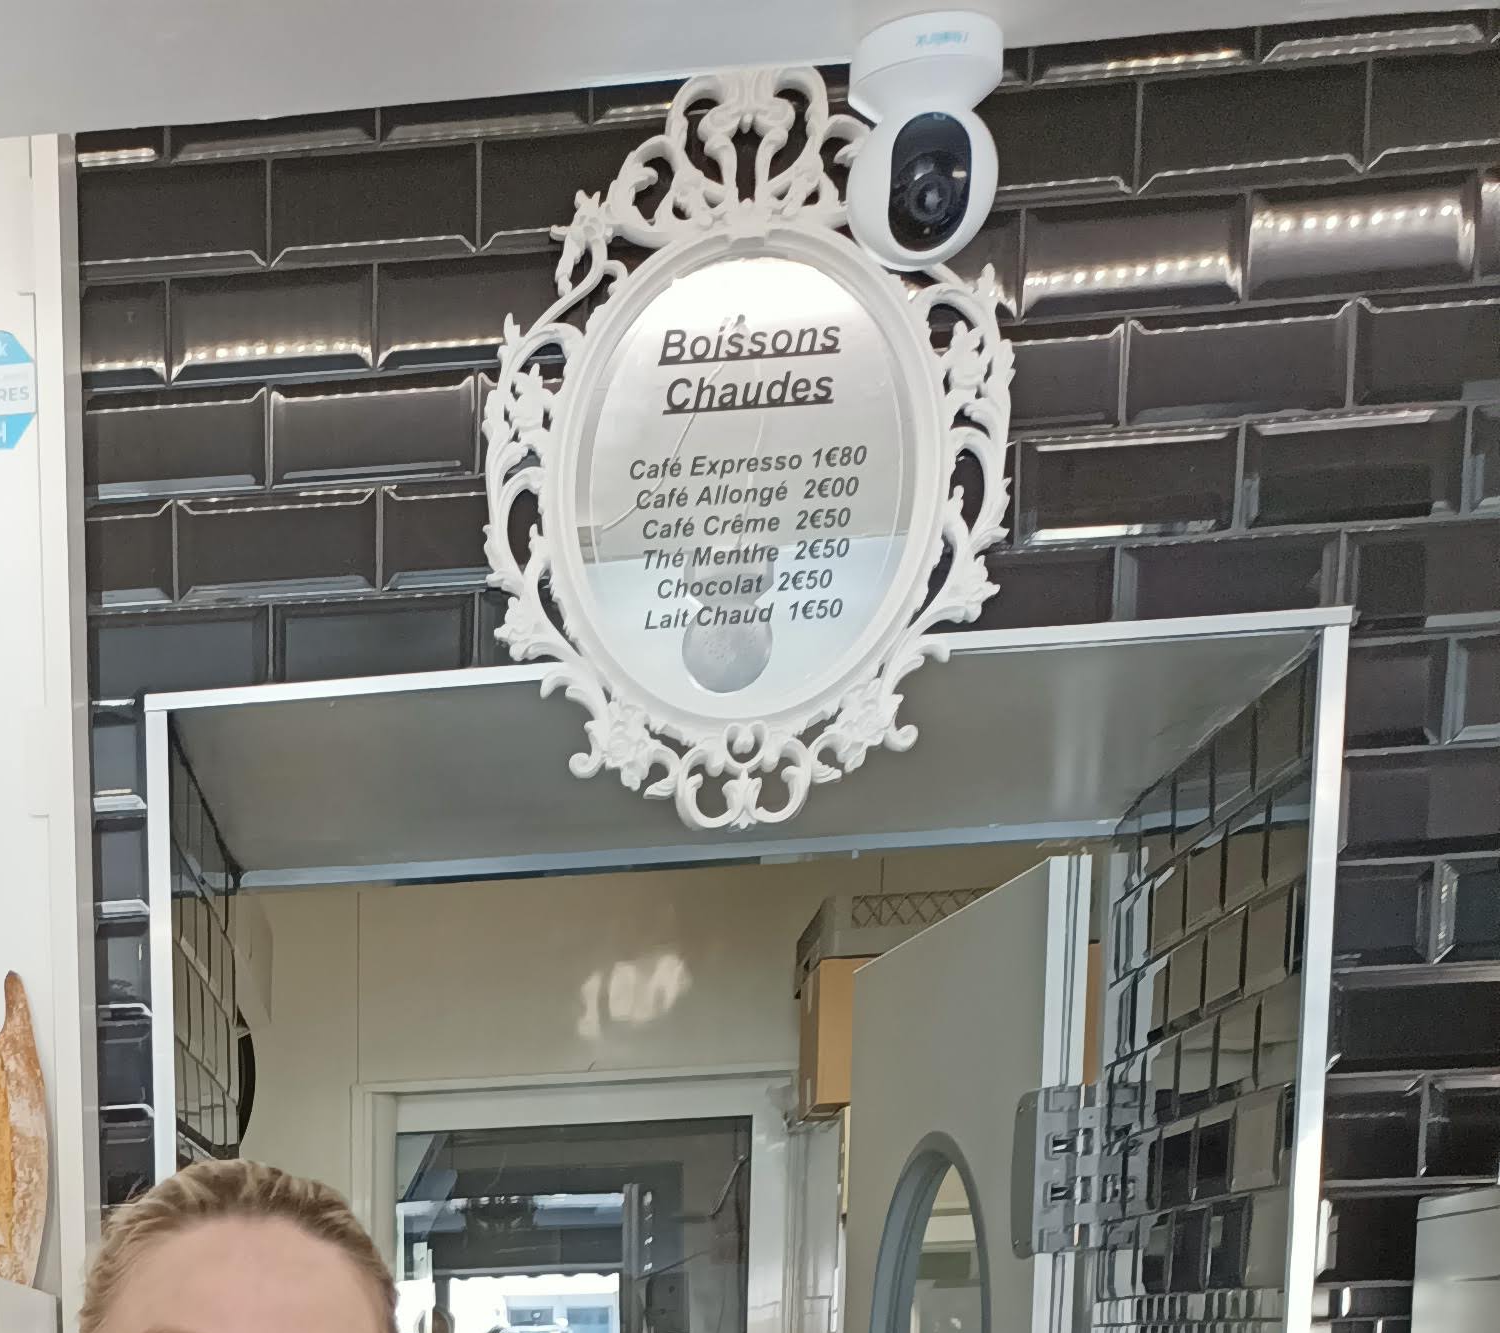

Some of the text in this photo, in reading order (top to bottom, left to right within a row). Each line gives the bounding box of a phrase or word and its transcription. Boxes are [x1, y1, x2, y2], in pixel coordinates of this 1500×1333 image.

[659, 323, 841, 364] Boissons
[665, 371, 835, 413] Chaudes
[629, 445, 868, 482] Café Expresso 1€80
[636, 476, 860, 510] Café Allongé 2€00
[642, 518, 695, 541] Café
[795, 507, 851, 531] 2€50
[643, 537, 850, 571] Thé Menthe 2€50
[657, 568, 833, 600] Chocolat 2€50
[644, 598, 844, 630] Lait Chaud 1€50
